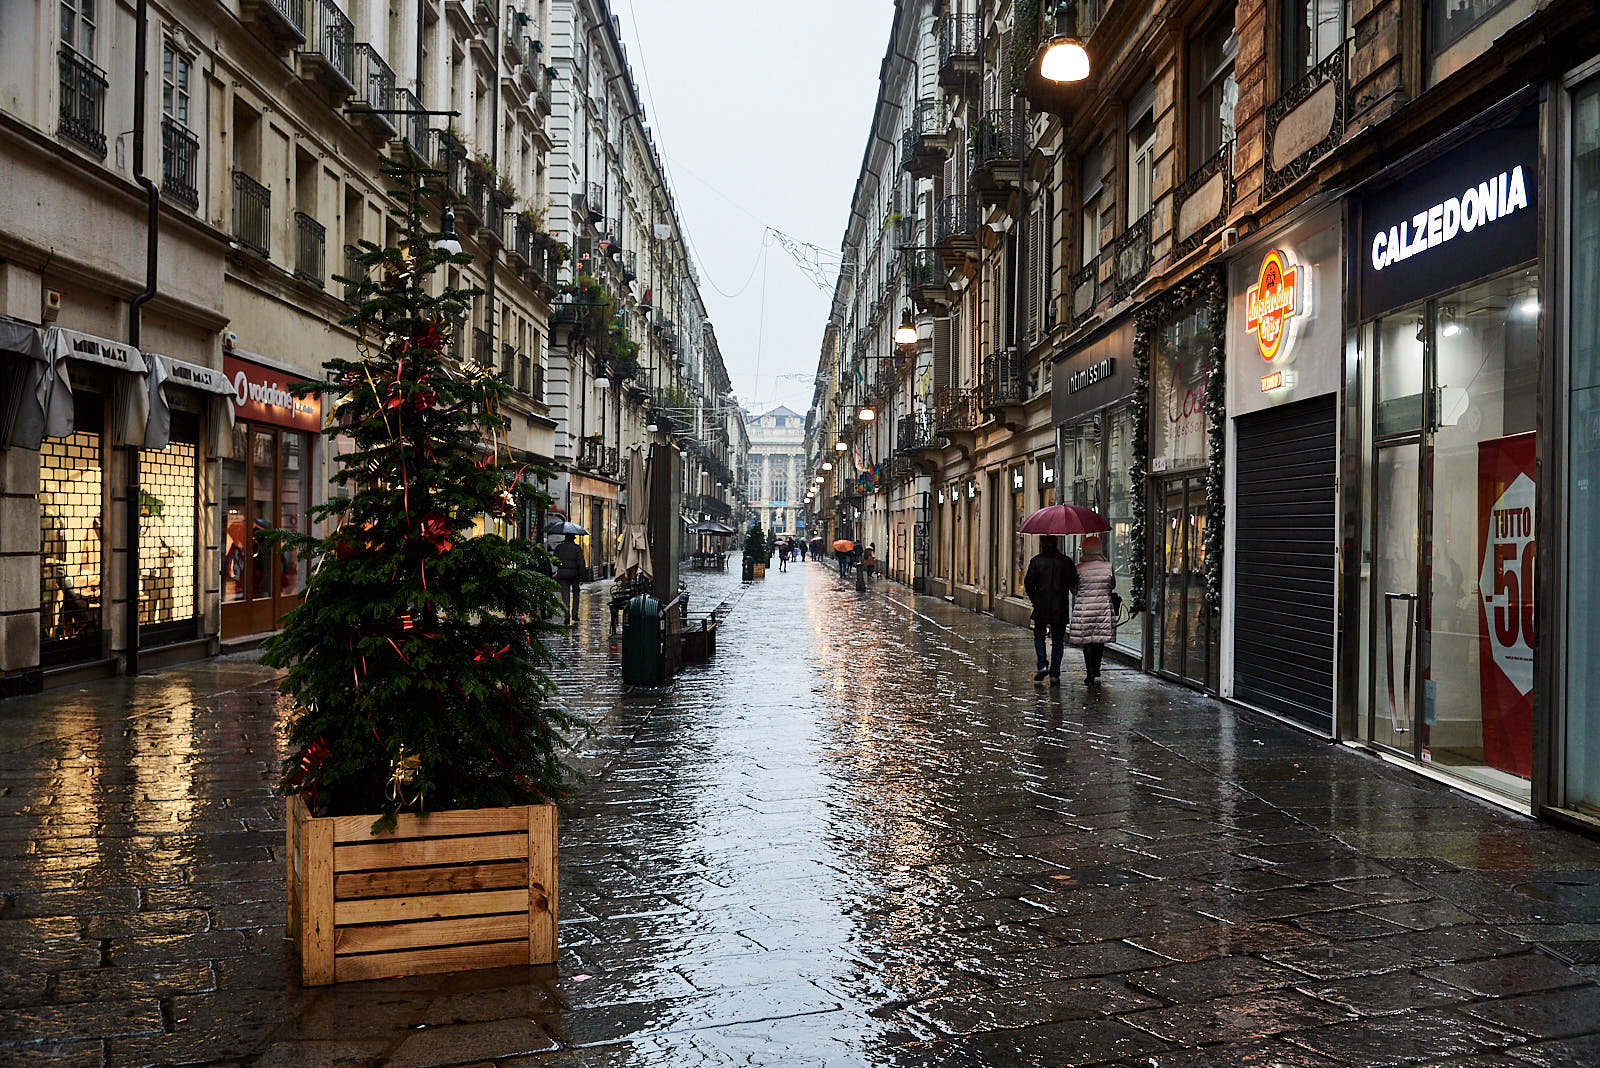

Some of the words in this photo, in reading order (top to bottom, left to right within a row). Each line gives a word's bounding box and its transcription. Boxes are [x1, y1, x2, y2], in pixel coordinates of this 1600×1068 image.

[1372, 165, 1527, 271] CALZEDONIA
[73, 338, 100, 355] MINI
[101, 345, 127, 362] MAXI
[172, 365, 191, 380] MINI
[193, 371, 212, 385] MAXI
[248, 380, 292, 410] vodafone
[1493, 506, 1531, 538] TUTTO
